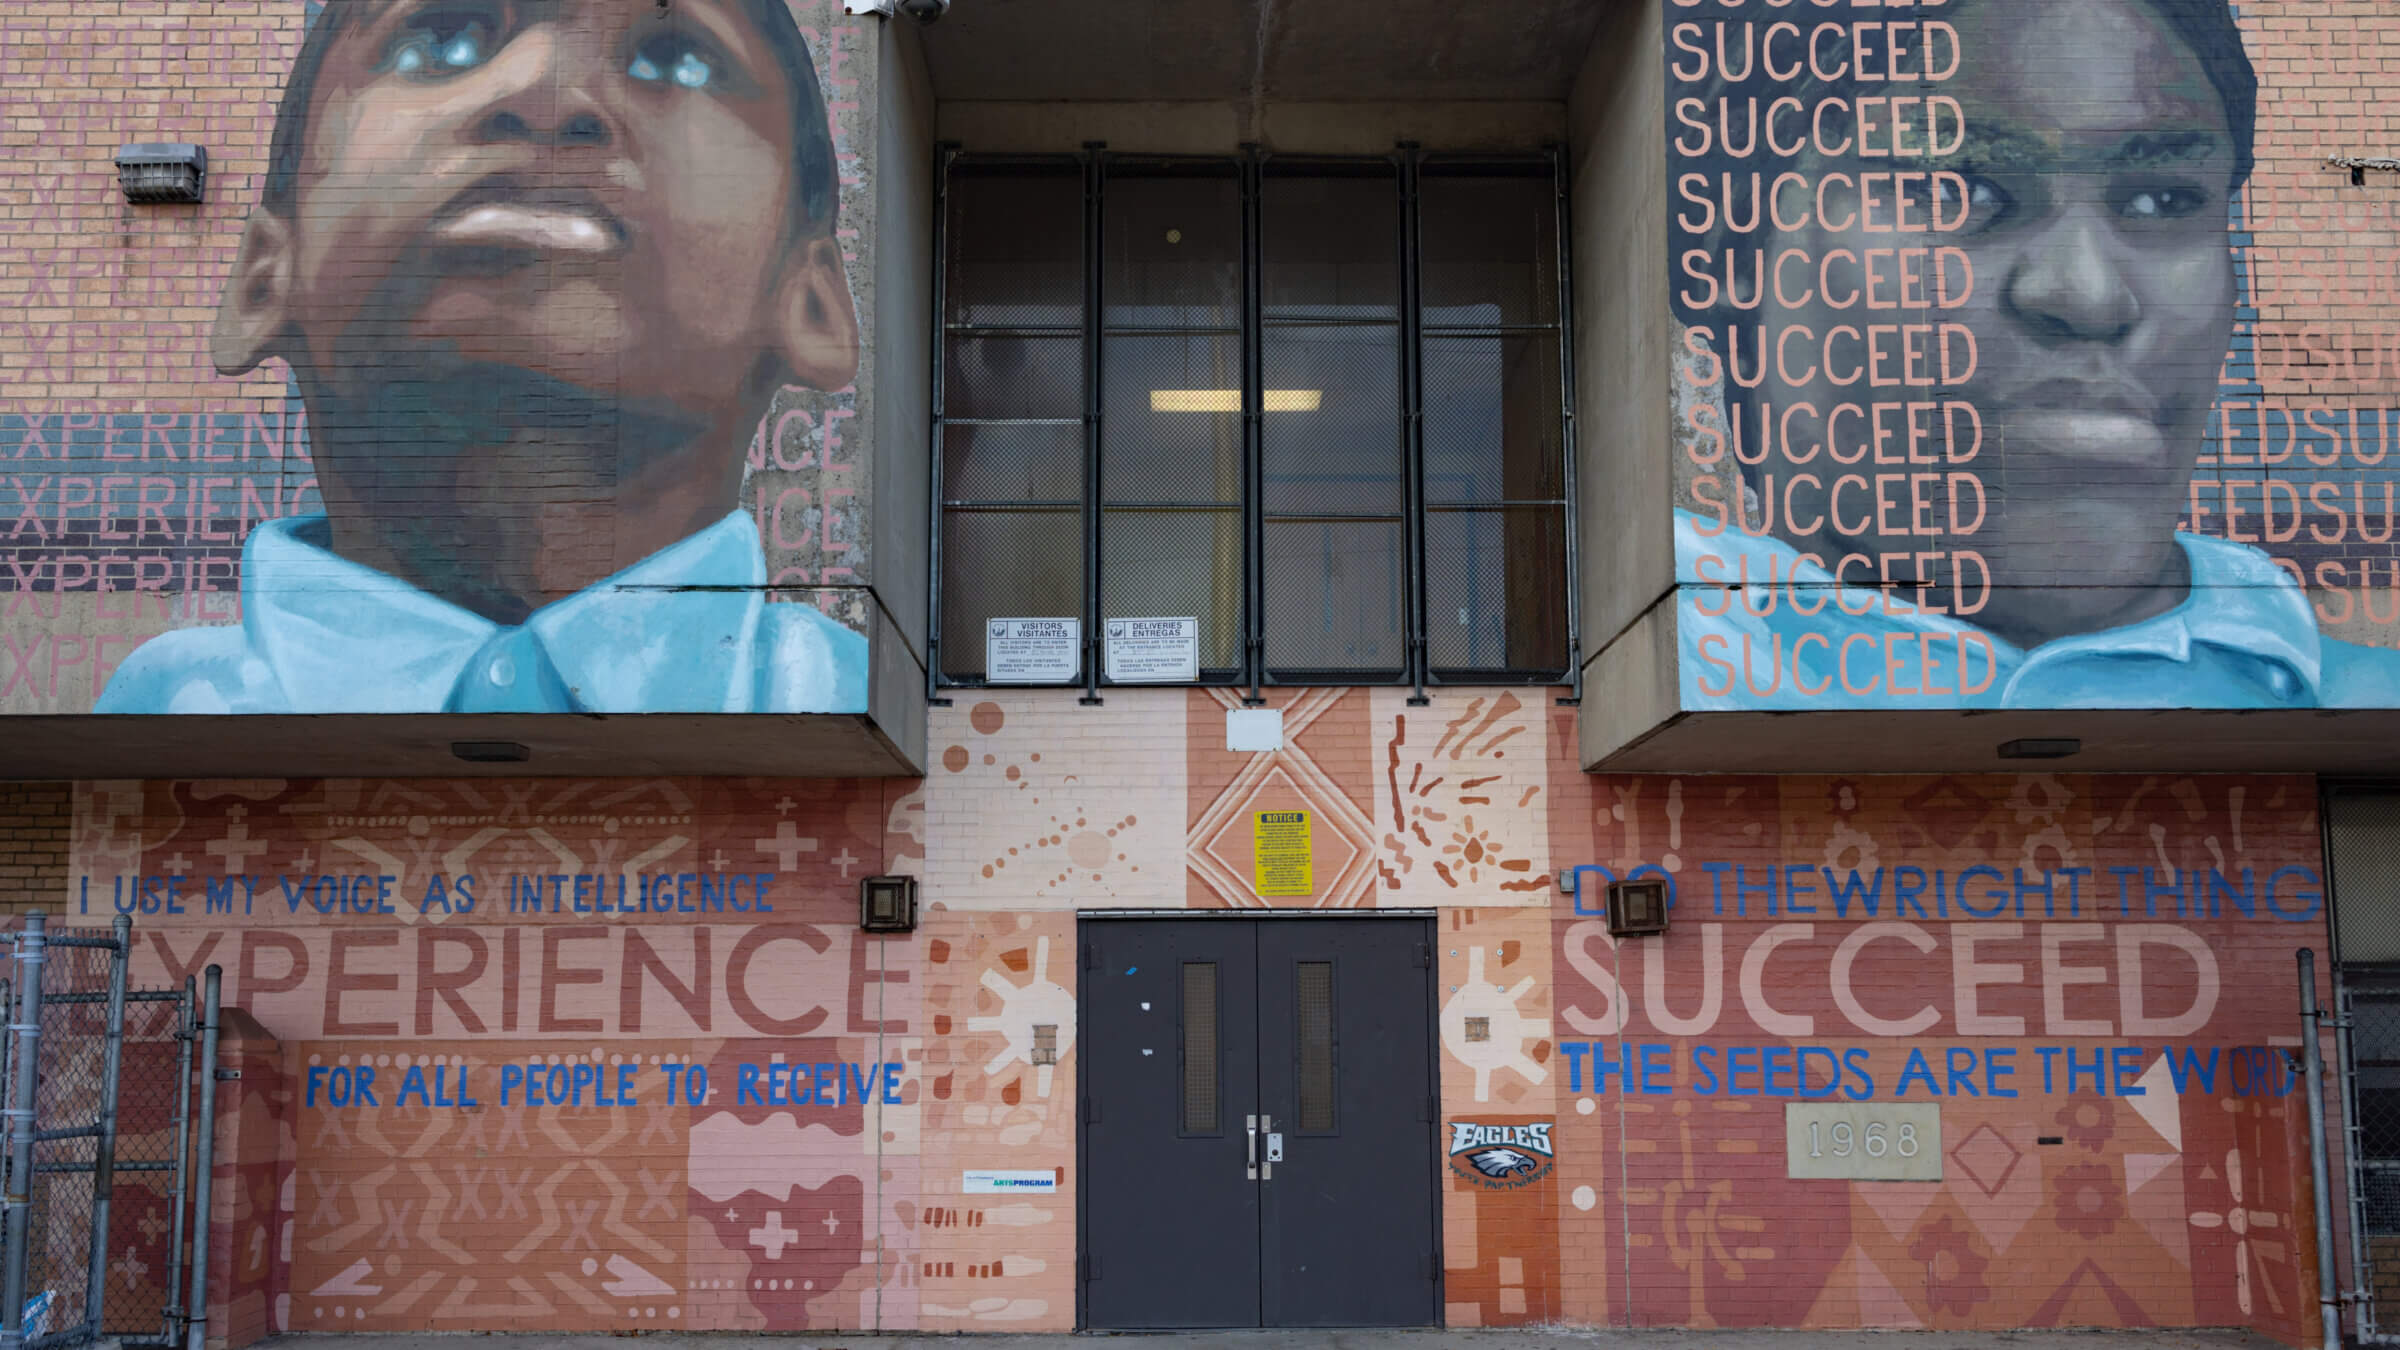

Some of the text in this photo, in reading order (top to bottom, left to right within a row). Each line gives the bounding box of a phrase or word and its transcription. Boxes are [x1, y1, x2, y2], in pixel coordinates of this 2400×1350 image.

[1672, 21, 1961, 82] SUCCEED
[1674, 97, 1966, 158] SUCCEED
[1677, 172, 1970, 233] SUCCEED
[1679, 247, 1975, 311] SUCCEED
[1683, 325, 1978, 388] SUCCEED
[0, 396, 315, 463] XPERIENC
[1687, 401, 1984, 465] SUCCEED
[0, 476, 317, 540] XPERIEN
[1691, 473, 1986, 537] SUCCEED
[4, 554, 243, 619] XPERIE
[1694, 551, 1992, 617] SUCCEED
[1017, 630, 1068, 638] VISITANTES
[1021, 622, 1063, 630] VISITORS
[1132, 622, 1183, 630] DELIVERIES
[1132, 629, 1181, 638] ENTREGAS
[2, 634, 158, 698] XPE
[1697, 631, 1997, 698] SUCCEED
[1266, 814, 1298, 823] NOTICE
[80, 872, 776, 915] I USE MY VOICE AS INTELLIGENCE
[2108, 864, 2323, 922] THING
[70, 922, 913, 1036] EXPERIENCE
[1561, 920, 2221, 1037] SUCCEED
[306, 1062, 904, 1108] FOR ALL PEOPLE TO RECEIVE
[1559, 1042, 1672, 1095] THE
[1692, 1044, 1875, 1100] SEEDS
[1895, 1046, 2018, 1098] ARE
[2034, 1045, 2147, 1097] THE
[1448, 1121, 1553, 1157] EAGLES
[1808, 1120, 1919, 1158] 1968
